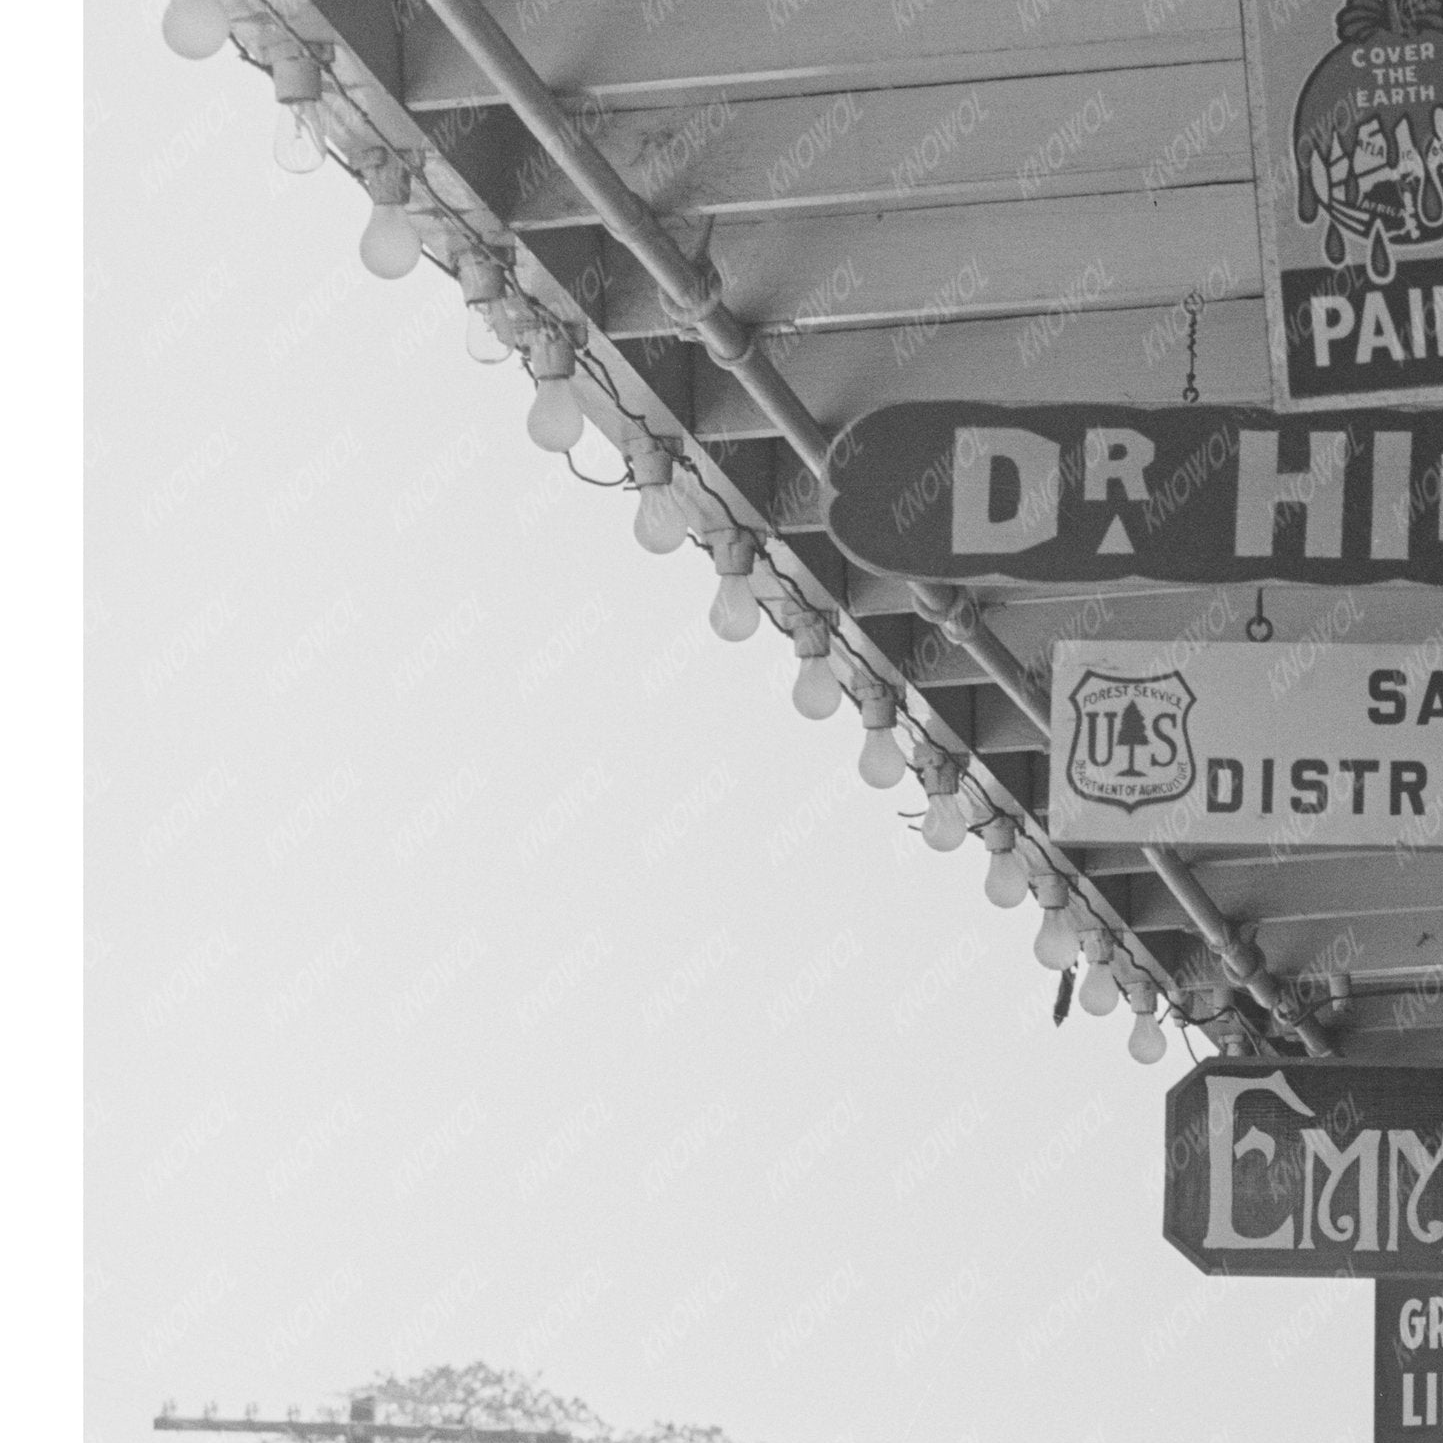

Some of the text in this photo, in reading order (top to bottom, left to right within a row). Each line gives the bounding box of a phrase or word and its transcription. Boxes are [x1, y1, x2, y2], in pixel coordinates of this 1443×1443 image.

[1351, 42, 1436, 68] COVER
[1372, 65, 1418, 85] THE
[1356, 85, 1436, 108] EARTH
[1083, 684, 1183, 711] FOREST SERVICE
[1125, 783, 1138, 796] OF
